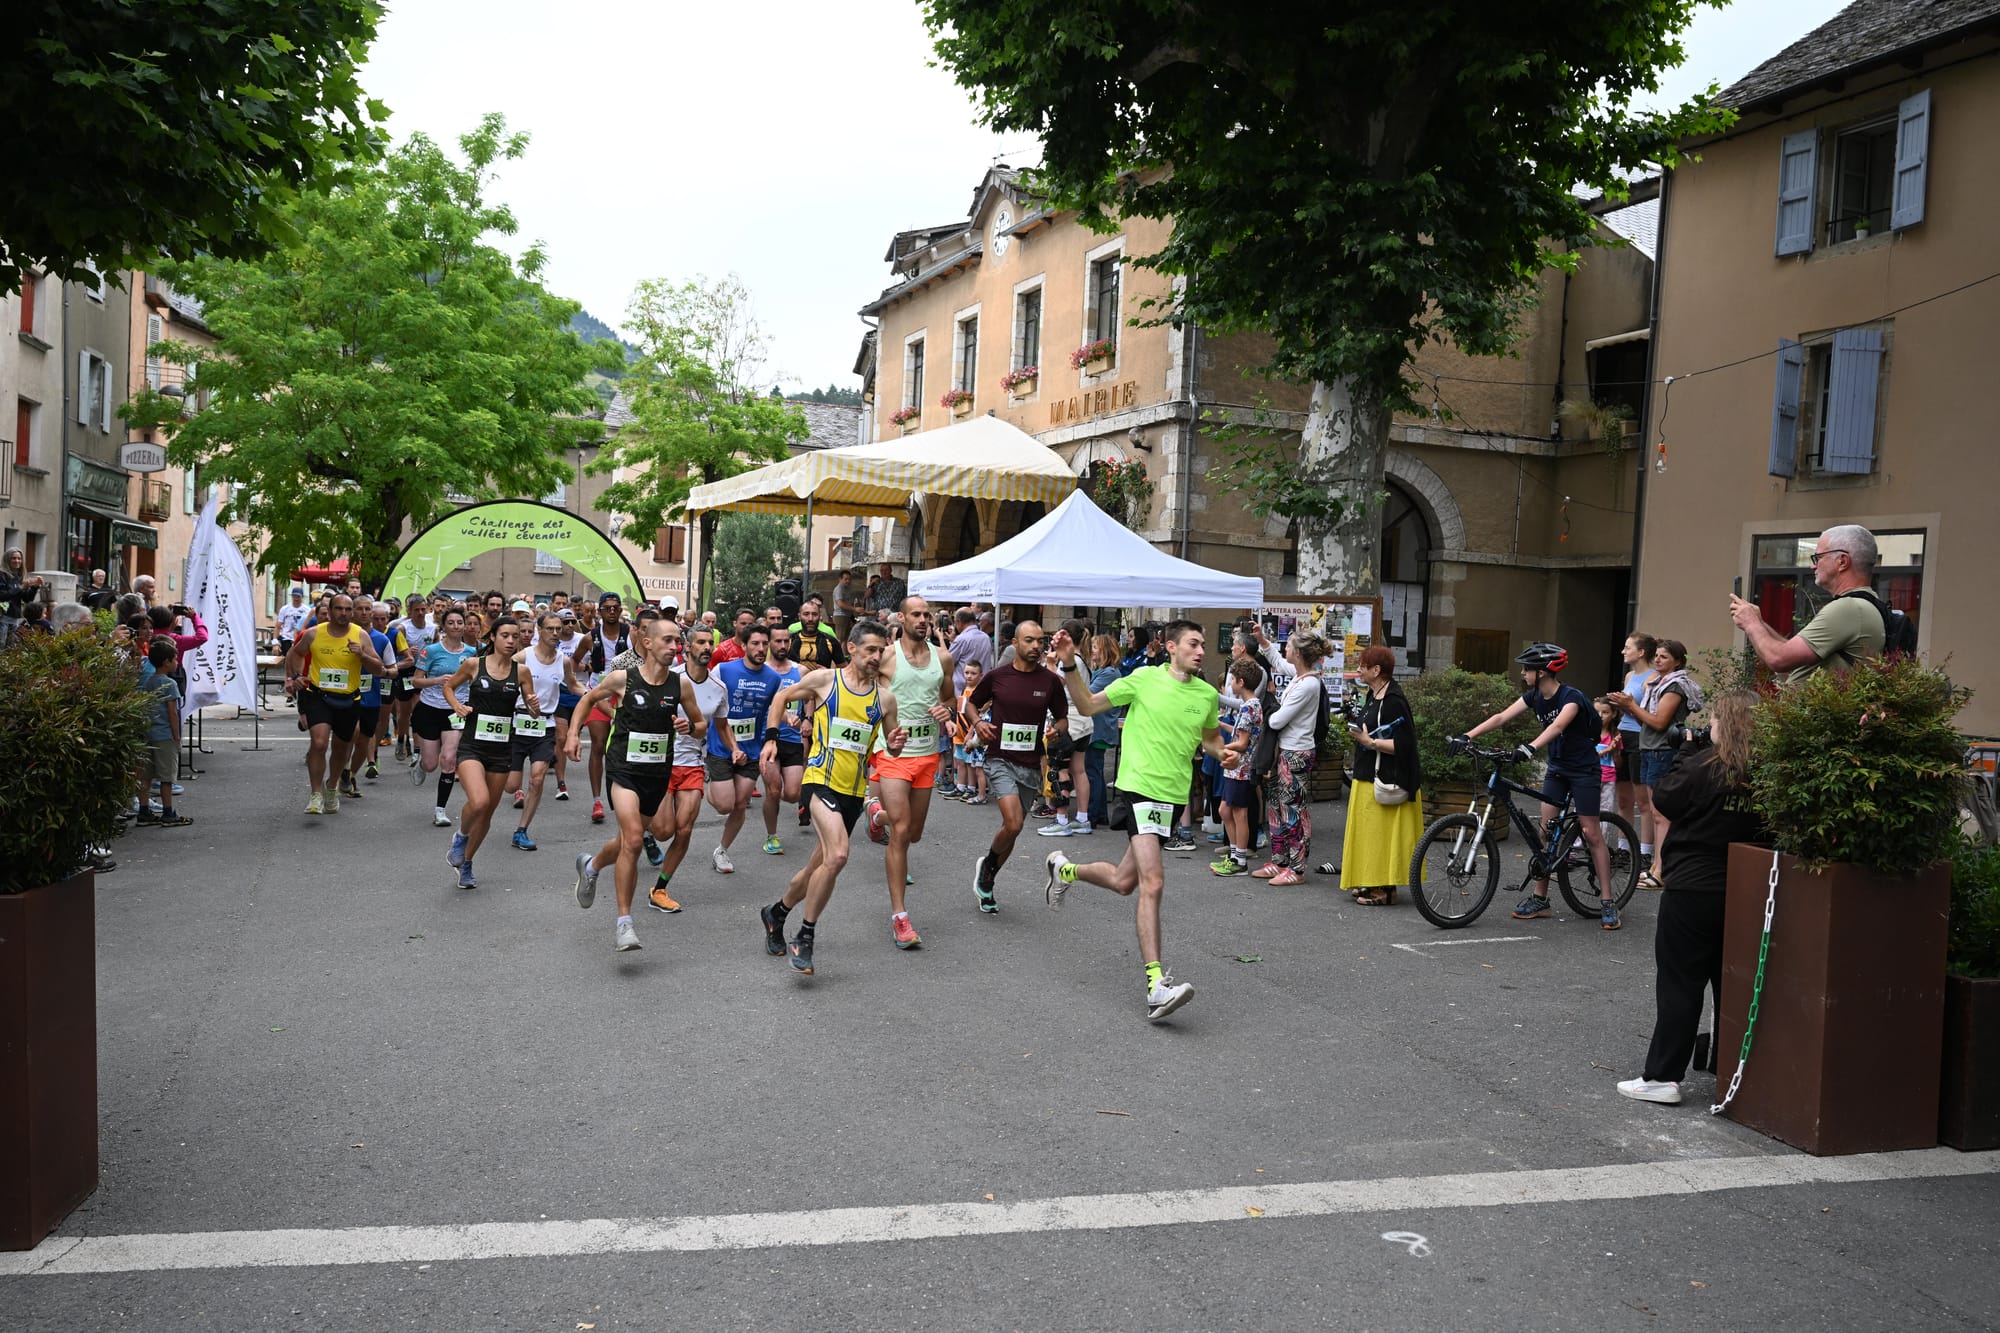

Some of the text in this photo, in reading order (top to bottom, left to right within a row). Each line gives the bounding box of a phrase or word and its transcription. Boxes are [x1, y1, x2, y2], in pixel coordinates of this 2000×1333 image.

[1050, 380, 1136, 425] MAIRIE
[125, 449, 161, 466] PIZZERIA
[469, 516, 564, 531] Challenge des
[461, 528, 572, 540] vallées cévenoles
[327, 674, 341, 683] 15
[486, 722, 503, 734] 56
[524, 720, 539, 730] 82
[731, 724, 751, 734] 101
[841, 727, 861, 742] 48
[908, 725, 930, 738] 115
[1007, 731, 1032, 742] 104
[639, 741, 659, 753] 55
[1147, 809, 1161, 825] 43
